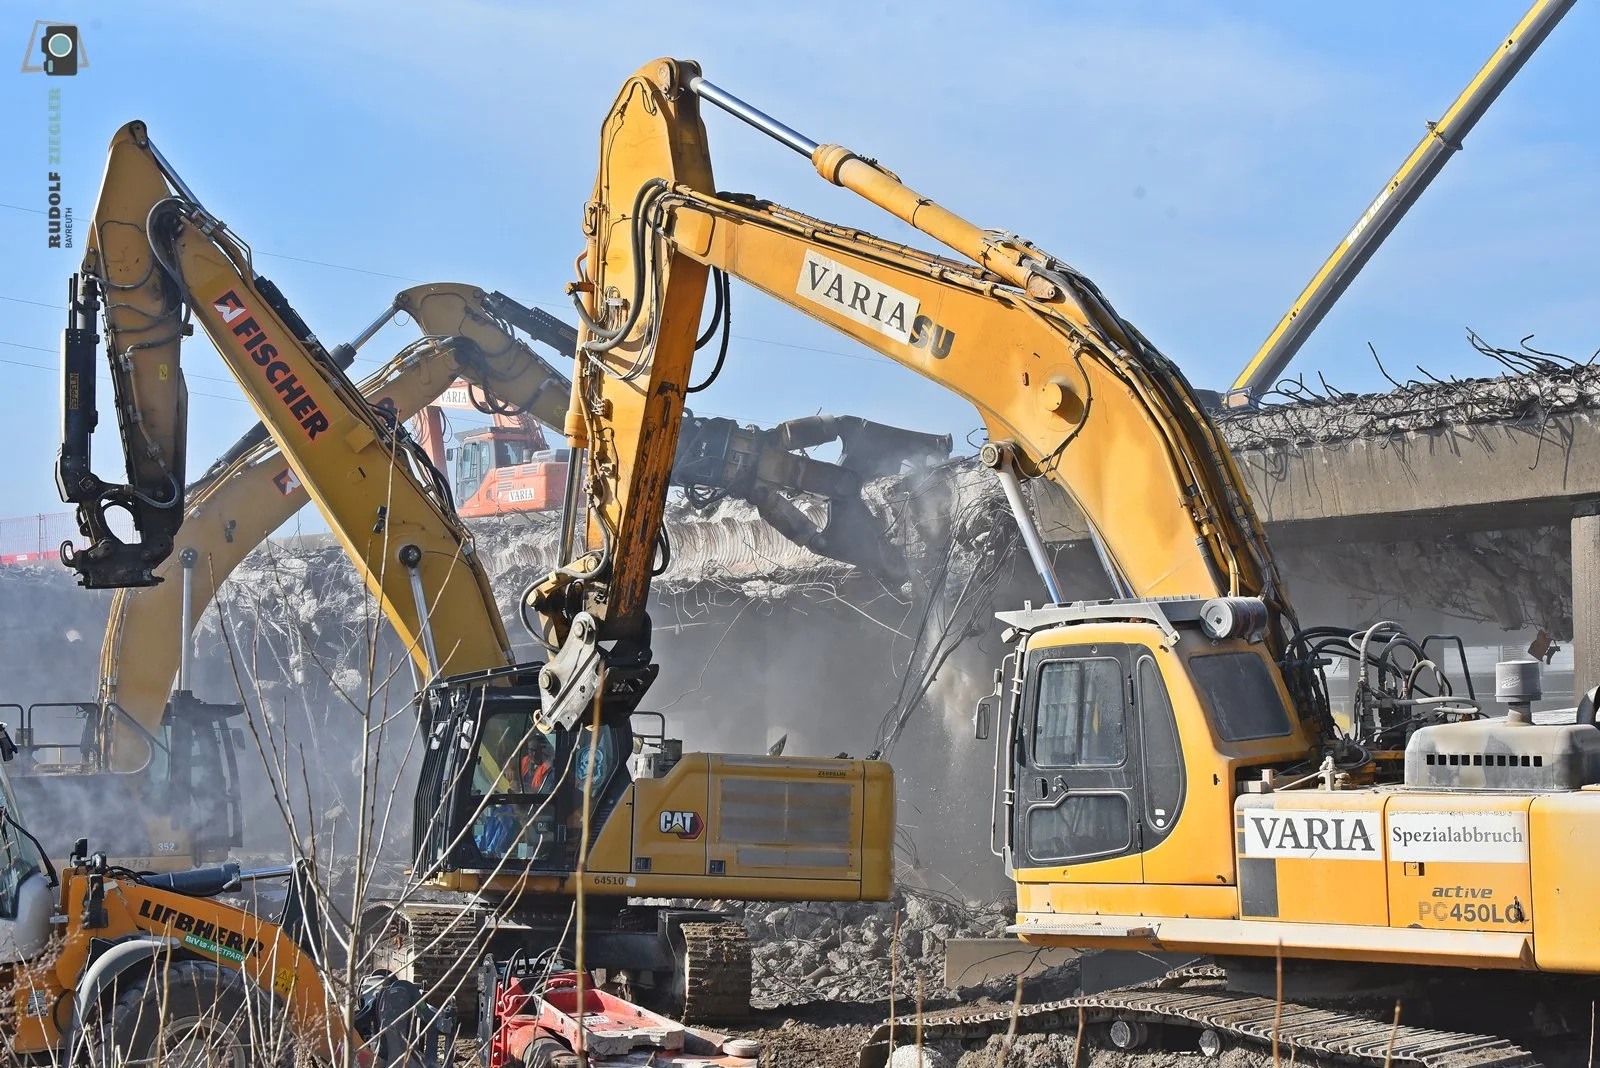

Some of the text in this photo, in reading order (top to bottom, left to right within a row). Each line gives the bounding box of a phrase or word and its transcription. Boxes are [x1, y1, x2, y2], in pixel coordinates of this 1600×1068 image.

[808, 260, 907, 333] VARIA
[232, 316, 329, 441] FISCHER
[441, 390, 467, 404] VARIA
[510, 490, 533, 501] VARIA
[660, 811, 694, 833] CAT
[1250, 817, 1376, 851] VARIA
[1392, 826, 1523, 847] Spezialabbruch
[158, 842, 175, 851] 352
[594, 876, 624, 885] 64510
[1432, 886, 1493, 899] active
[210, 944, 245, 962] METPARK
